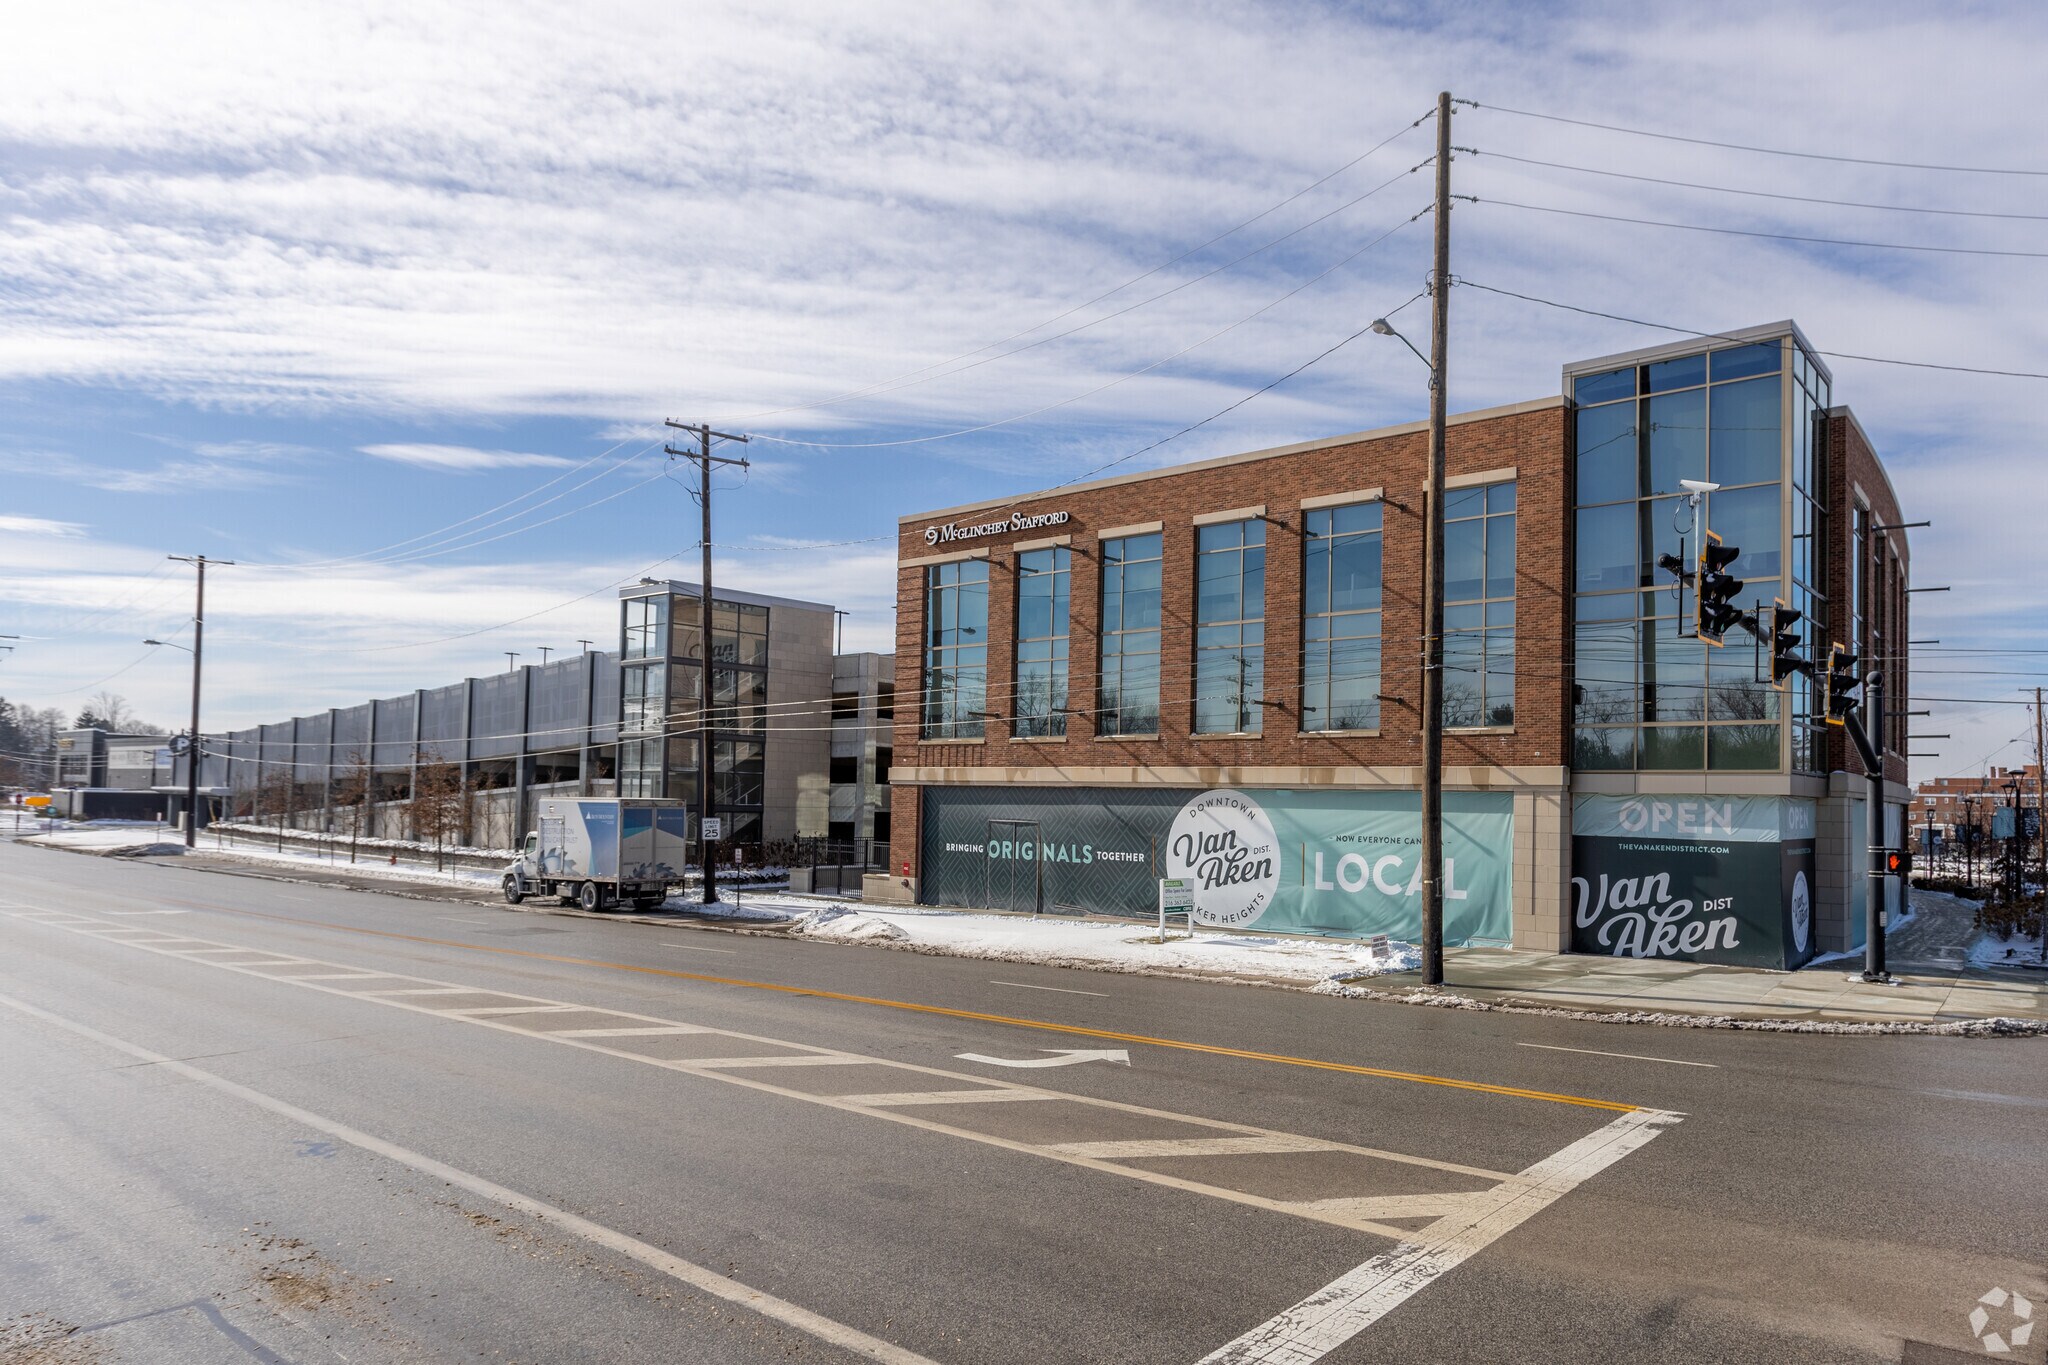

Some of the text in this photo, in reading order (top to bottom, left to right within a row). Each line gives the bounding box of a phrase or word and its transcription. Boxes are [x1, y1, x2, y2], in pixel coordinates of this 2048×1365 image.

[1011, 511, 1069, 530] STAFFORD
[177, 738, 190, 751] P
[1189, 797, 1256, 820] DOWNTOWN
[1618, 800, 1733, 835] OPEN
[1788, 806, 1809, 829] OPEN
[704, 829, 719, 838] 25
[1336, 835, 1422, 845] NOW EVERYONE CAN
[946, 842, 984, 853] BRINGING
[1096, 851, 1145, 863] TOGETHER
[1173, 829, 1237, 868] Van
[1618, 843, 1730, 854] THEVANAKENDISTRICT.COM
[1197, 847, 1272, 890] Aken
[1221, 892, 1265, 923] HEIGHTS
[1572, 872, 1672, 928] Van
[1703, 897, 1733, 912] DIST
[1598, 899, 1740, 958] Aken
